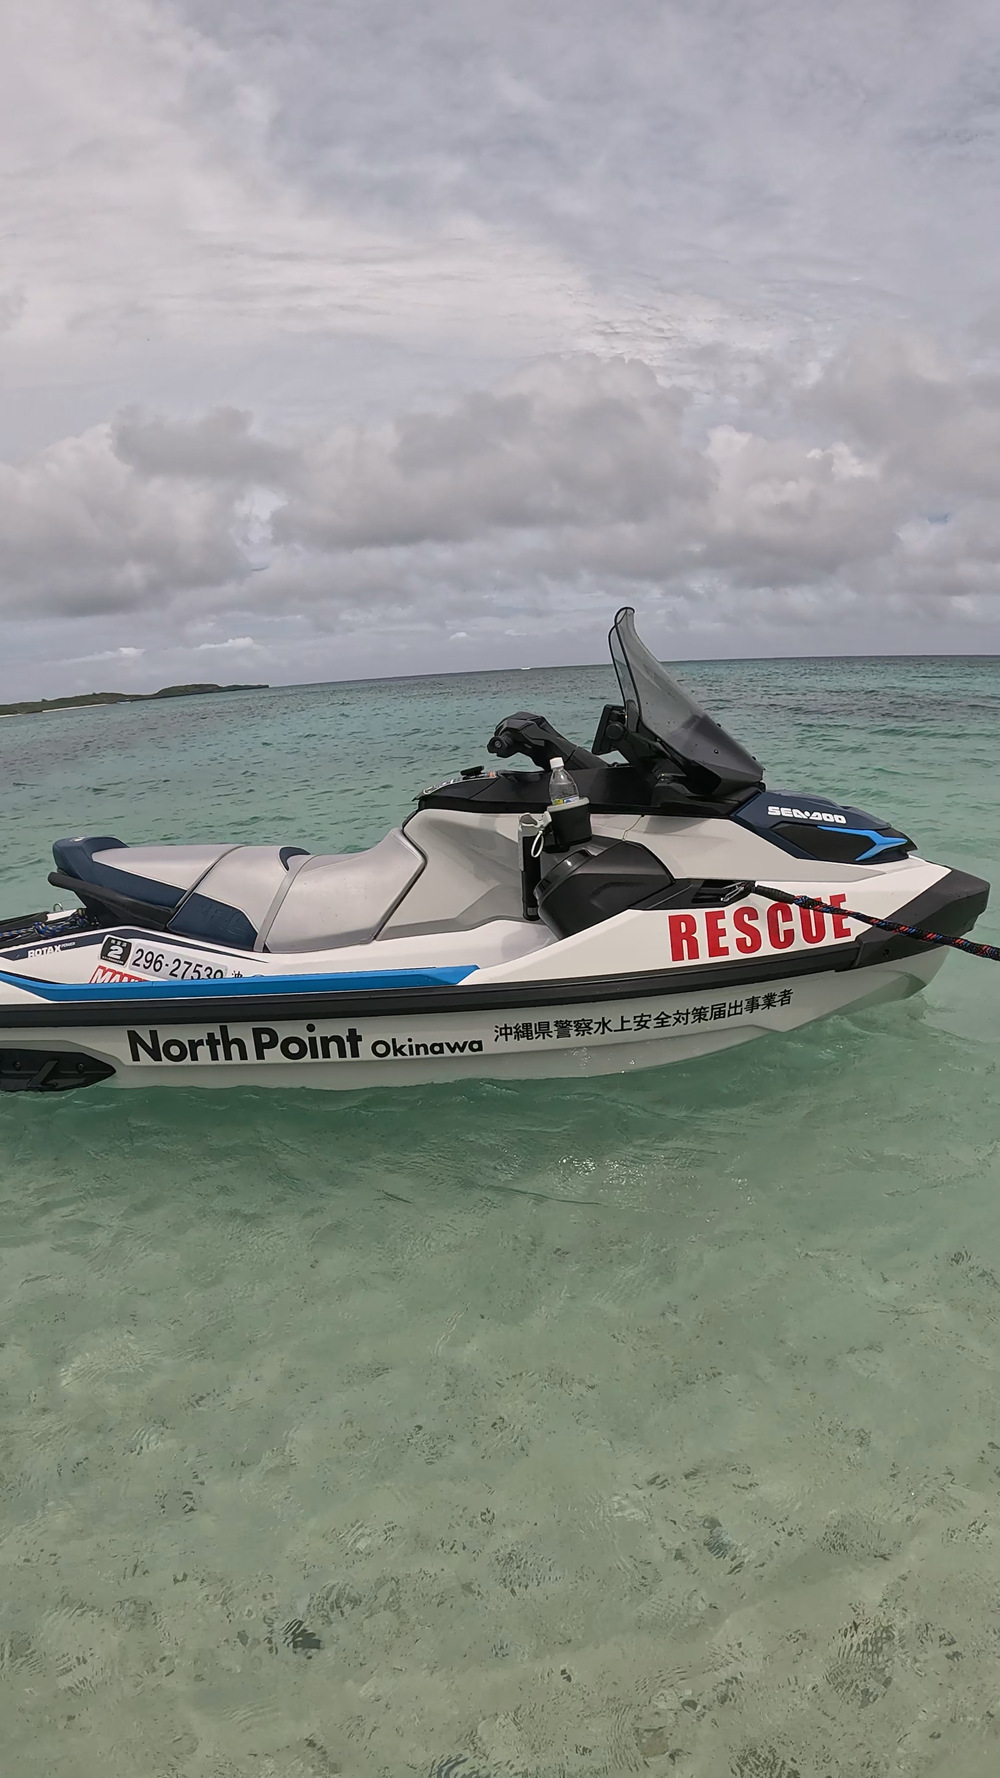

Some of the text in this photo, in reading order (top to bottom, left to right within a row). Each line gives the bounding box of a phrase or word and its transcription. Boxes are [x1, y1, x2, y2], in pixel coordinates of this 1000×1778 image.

[667, 893, 852, 962] RESCUE
[27, 944, 62, 958] ROTAX
[107, 945, 124, 960] 2
[493, 988, 794, 1042] 沖縄県警察水上安全対策届出事業者
[371, 1037, 484, 1058] Okinawa
